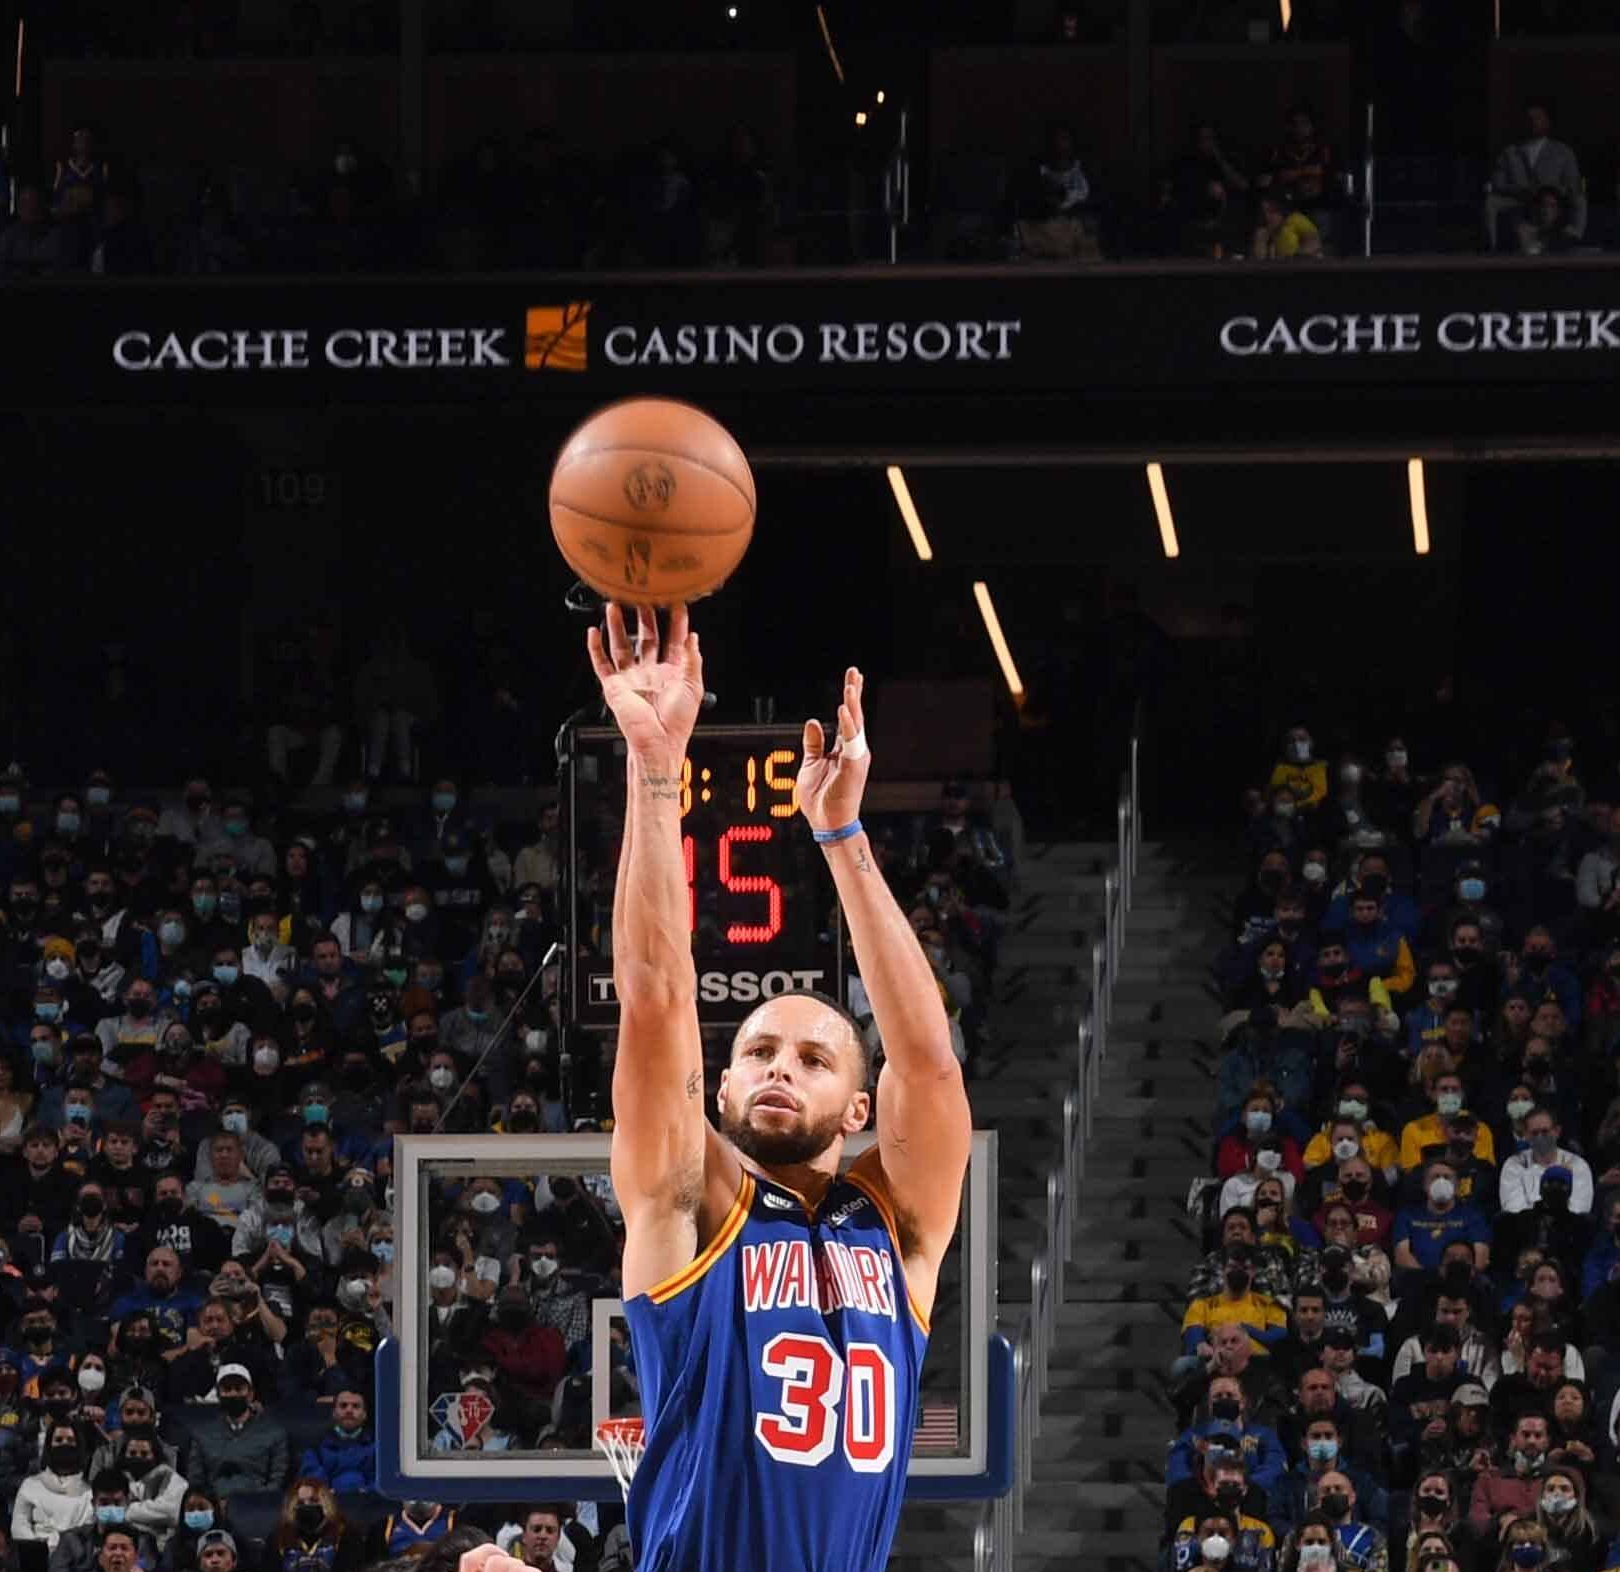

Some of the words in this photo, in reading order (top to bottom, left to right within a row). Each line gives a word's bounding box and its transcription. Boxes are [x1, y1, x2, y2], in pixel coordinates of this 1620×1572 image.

[111, 331, 310, 370] CACHE
[323, 329, 508, 368] CREEK
[603, 325, 805, 365] CASINO
[818, 320, 1022, 361] RESORT
[1219, 314, 1422, 355] CACHE
[260, 470, 325, 505] 109
[680, 750, 801, 820] :15
[693, 969, 824, 1002] SSOT
[754, 1331, 895, 1474] 30
